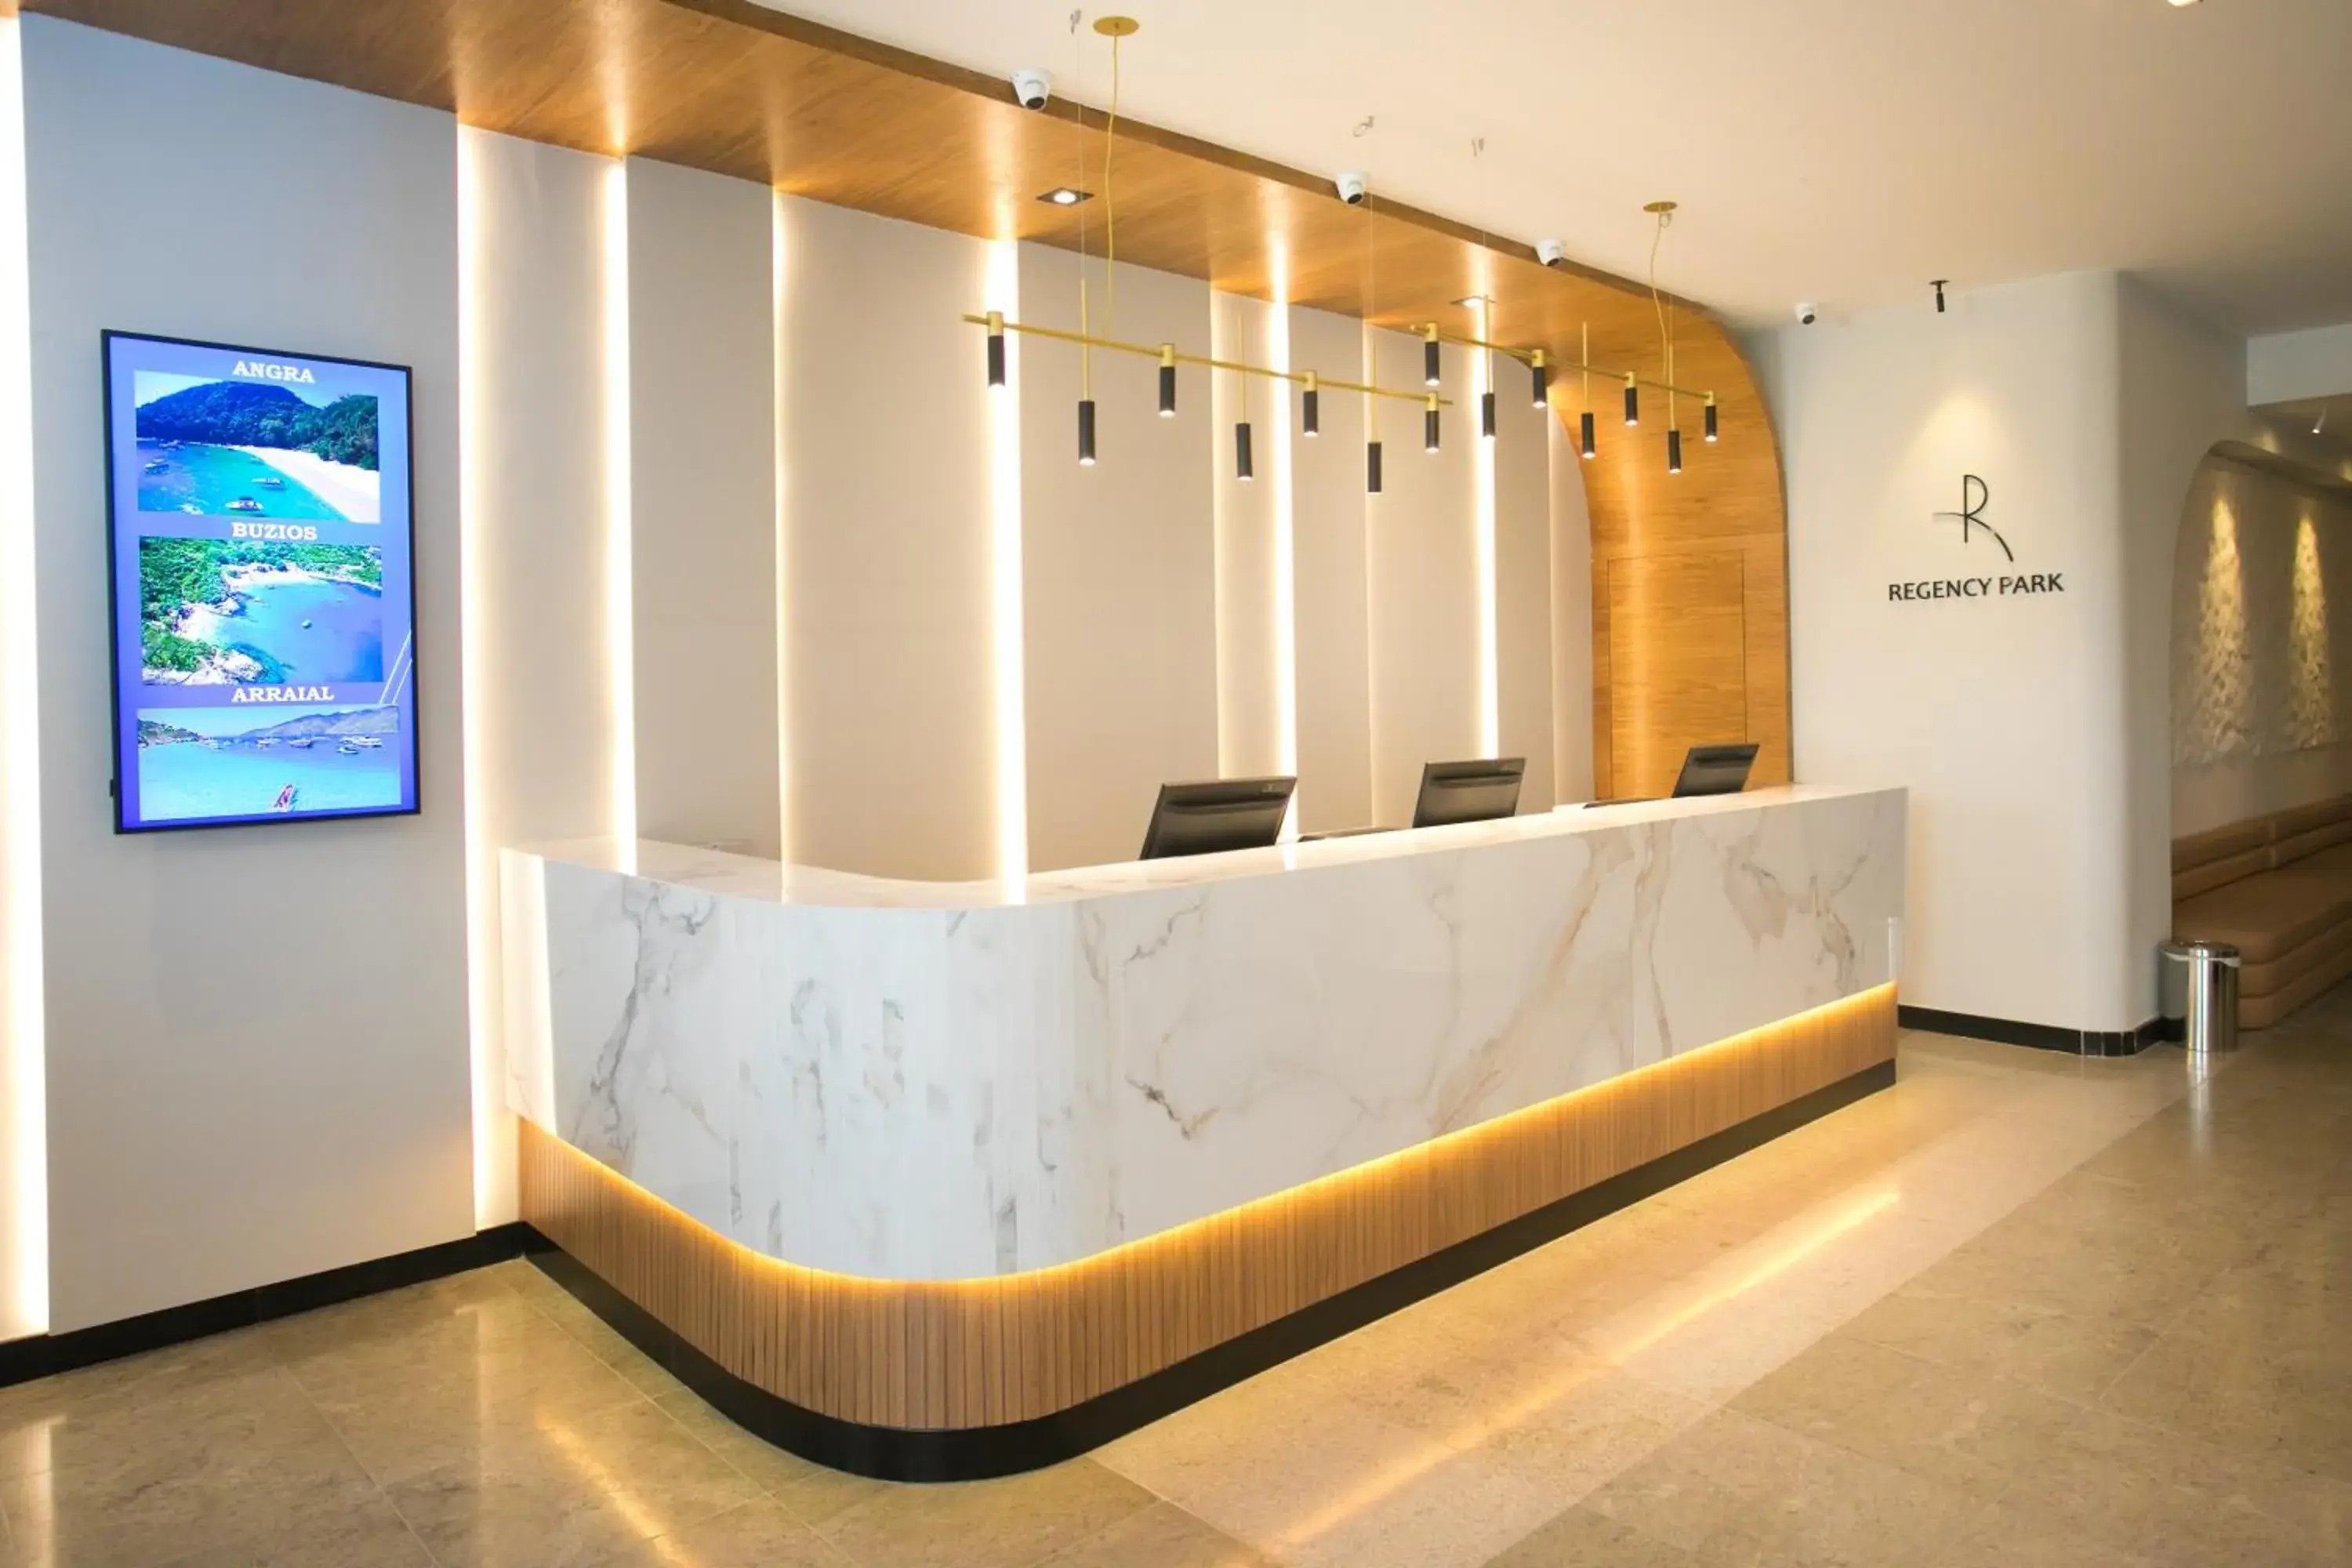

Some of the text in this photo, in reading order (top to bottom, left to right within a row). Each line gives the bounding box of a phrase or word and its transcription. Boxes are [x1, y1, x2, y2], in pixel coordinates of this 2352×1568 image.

[233, 361, 315, 383] ANGRA
[232, 522, 318, 540] BUZIOS
[1888, 573, 2064, 601] REGENCY PARK
[232, 686, 334, 702] ARRAIAL
